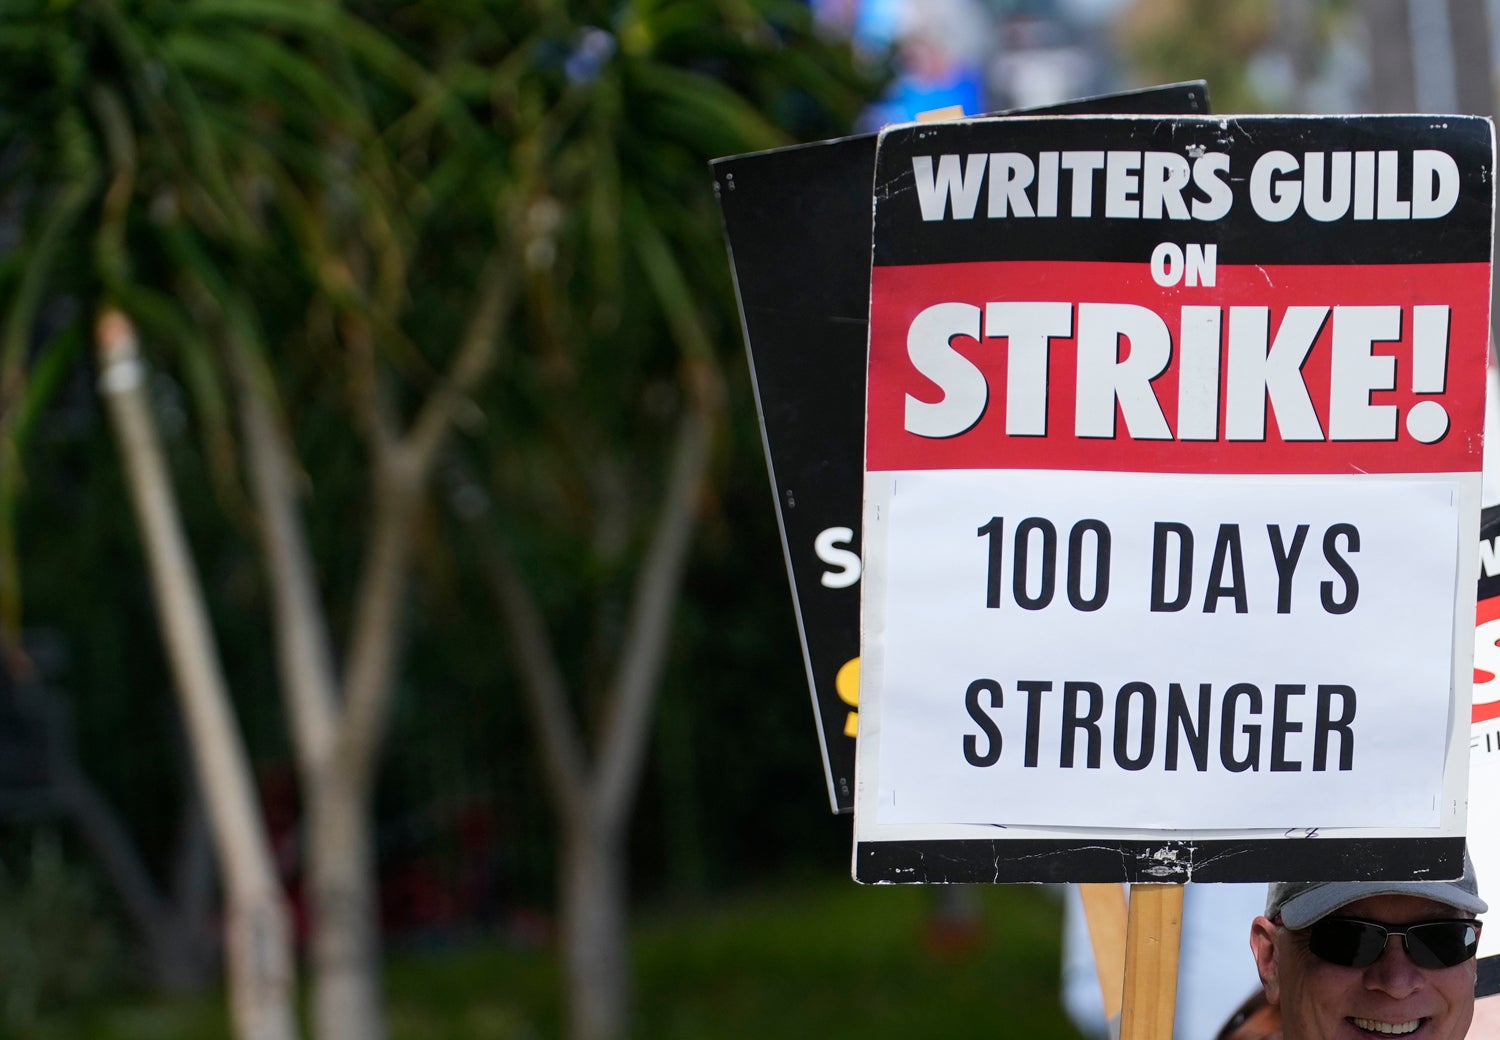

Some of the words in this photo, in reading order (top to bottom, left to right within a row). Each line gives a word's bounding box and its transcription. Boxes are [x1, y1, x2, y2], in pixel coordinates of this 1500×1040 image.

[912, 151, 1233, 221] WRITERS
[1249, 150, 1460, 221] GUILD
[1150, 242, 1217, 287] ON
[904, 302, 1450, 444] STRIKE!
[977, 517, 1110, 611] 100
[1152, 522, 1361, 615] DAYS
[963, 678, 1357, 773] STRONGER
